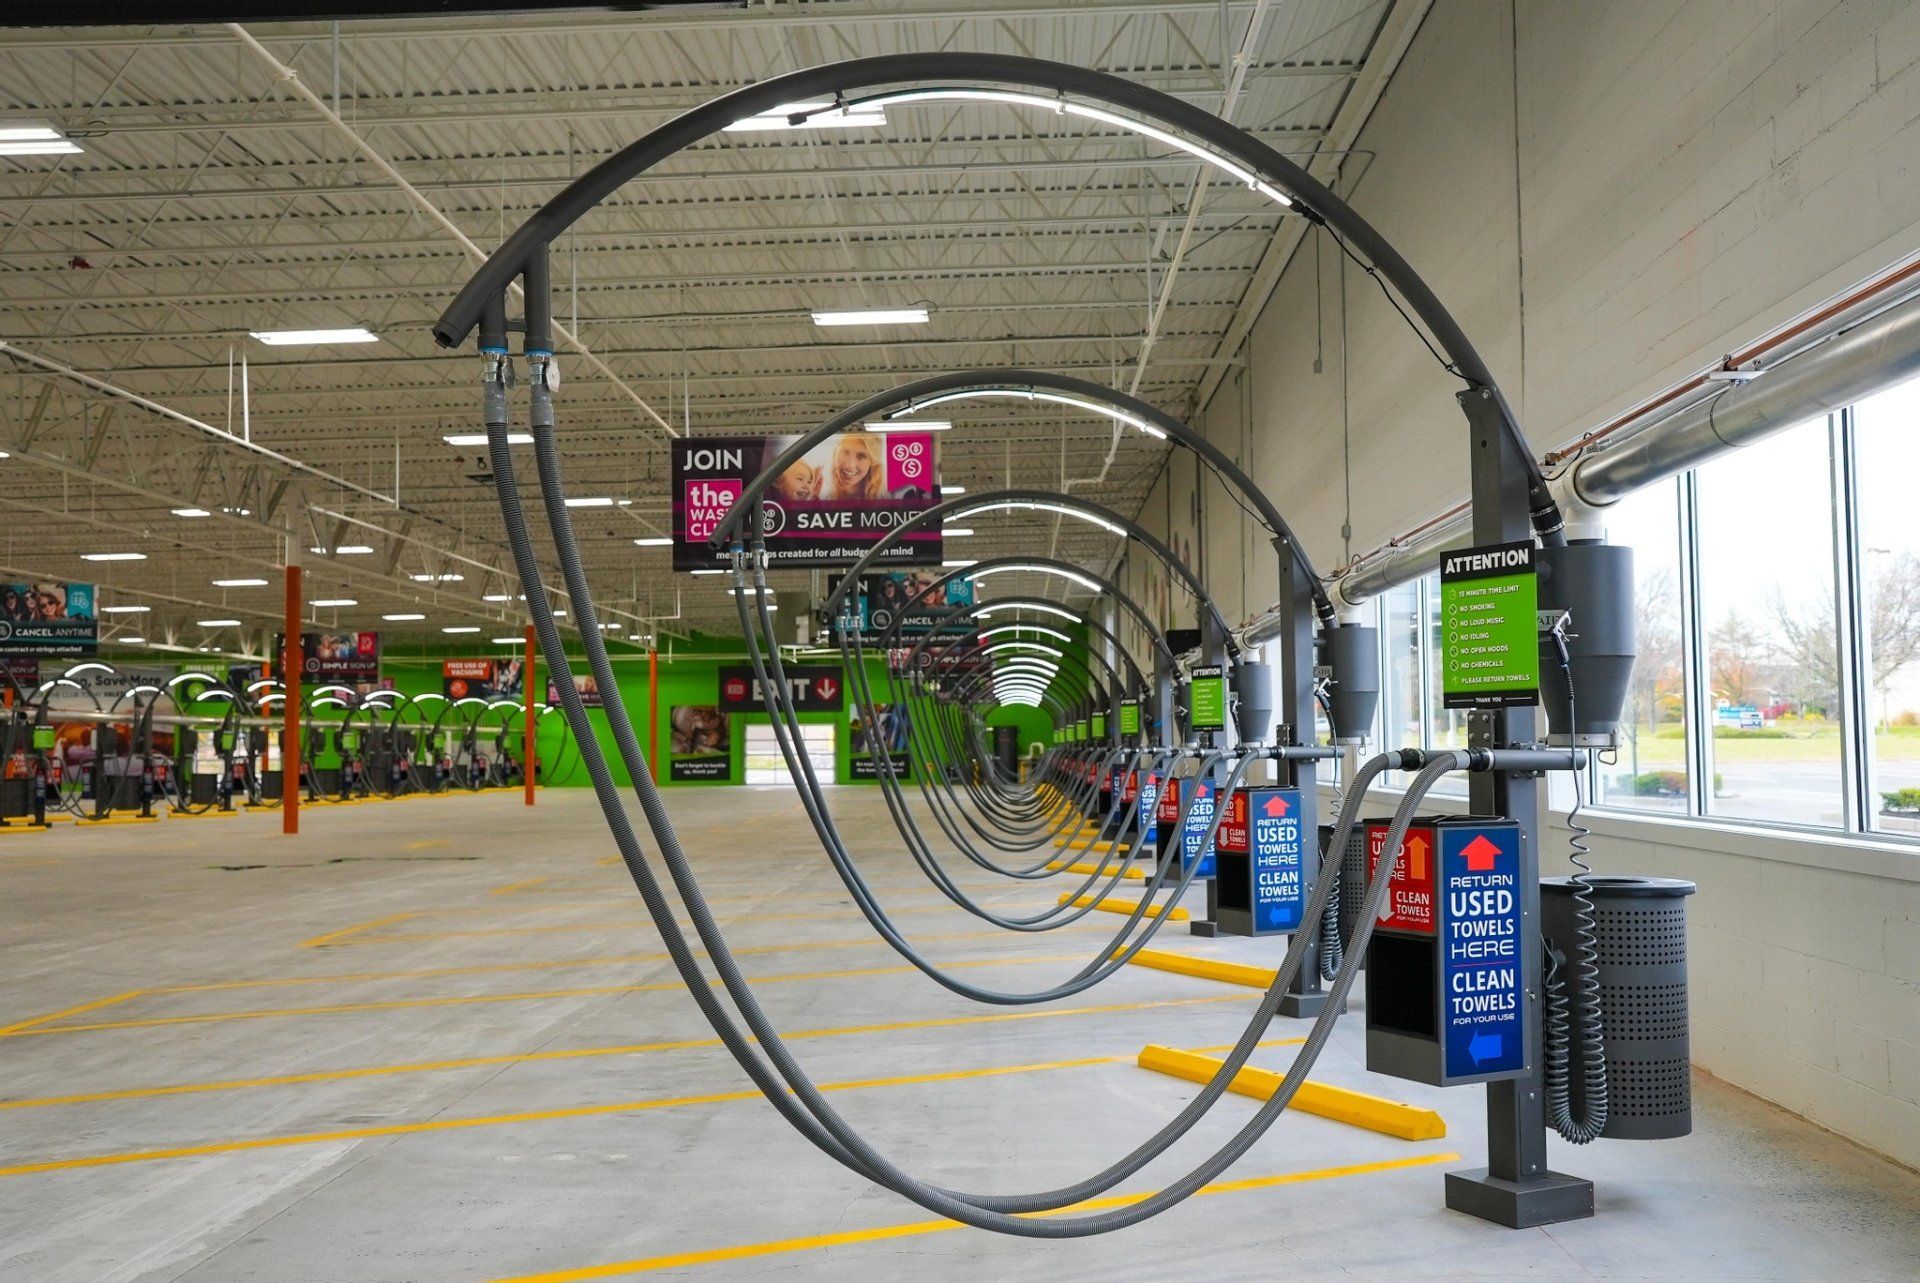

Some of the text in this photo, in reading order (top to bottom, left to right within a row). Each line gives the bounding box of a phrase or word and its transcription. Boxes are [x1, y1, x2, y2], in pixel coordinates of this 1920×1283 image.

[683, 449, 742, 471] JOIN
[690, 483, 735, 507] the
[690, 509, 729, 521] WAS
[797, 512, 853, 529] SAVE
[778, 549, 813, 558] created
[815, 548, 828, 557] for
[830, 548, 840, 556] all
[890, 546, 913, 555] mind
[1445, 548, 1529, 574] ATTENTION
[1466, 589, 1487, 597] MINUTE
[1503, 585, 1520, 593] LIMIT
[1470, 603, 1495, 611] SMOKING
[902, 617, 933, 625] ANCEL
[15, 628, 94, 637] CANCEL ANYTIME
[1487, 645, 1509, 653] HOODS
[1471, 660, 1503, 668] CHEMICALS
[1193, 668, 1221, 676] ATTENTION
[95, 675, 125, 685] Save
[130, 674, 162, 685] More
[1142, 790, 1156, 798] USE
[1257, 818, 1297, 826] RETURN
[1257, 826, 1297, 842] USED
[1372, 831, 1388, 839] RET
[1258, 843, 1298, 854] TOWELS
[1372, 840, 1405, 857] UD
[1258, 854, 1298, 867] HERE
[1259, 871, 1298, 885] CLEAN
[1451, 875, 1513, 888] RETURN
[1259, 885, 1299, 897] TOWELS
[1396, 891, 1430, 905] CLEAN
[1451, 890, 1513, 917] USED
[1396, 904, 1430, 917] TOWELS
[1451, 918, 1514, 938] TOWELS
[1451, 939, 1514, 959] HERE
[1452, 968, 1514, 993] CLEAN
[1452, 993, 1516, 1014] TOWELS
[1473, 1015, 1496, 1023] YOUR
